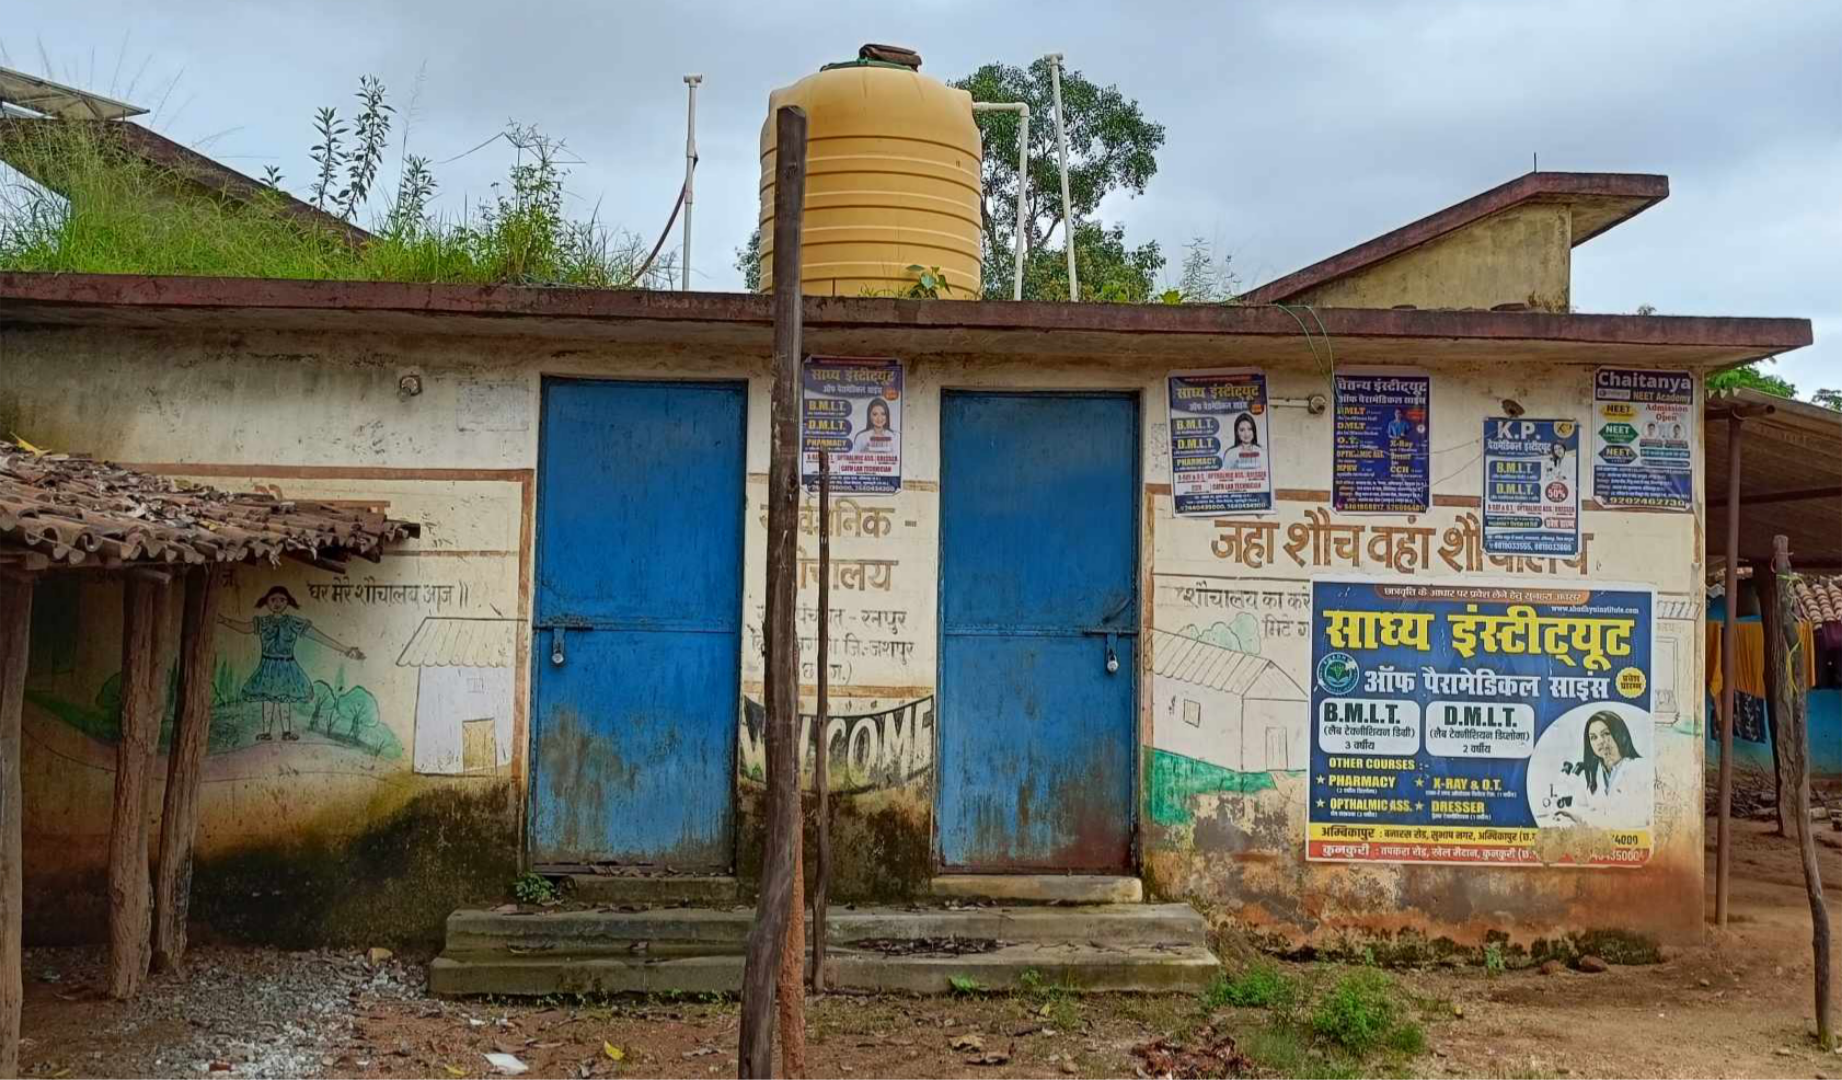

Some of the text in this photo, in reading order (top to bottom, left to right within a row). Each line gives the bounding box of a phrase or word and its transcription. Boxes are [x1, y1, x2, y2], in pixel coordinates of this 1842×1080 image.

[1598, 371, 1691, 392] Chaitanya
[1606, 404, 1631, 413] NEET
[1646, 403, 1688, 412] Admission
[1655, 413, 1677, 422] Open
[1336, 422, 1366, 430] DMLT
[1497, 421, 1541, 440] K.P.
[1605, 425, 1630, 434] NEET
[1605, 448, 1630, 457] NEET
[1283, 507, 1366, 568] शौच
[1367, 515, 1437, 574] वहां
[308, 583, 328, 599] घर
[332, 576, 352, 601] मेरे
[1430, 588, 1455, 598] आधार
[1457, 589, 1469, 598] पर
[1323, 604, 1635, 671] साध्य इंस्टीट्यूट
[1364, 665, 1417, 693] ऑफ
[1421, 666, 1541, 698] पैरामेडिकल
[1548, 670, 1610, 701] साइंस
[1324, 702, 1401, 724] B.M.L.T.
[1444, 705, 1517, 728] D.M.L.T.
[1344, 738, 1375, 750] 3 वर्षीय
[1462, 742, 1491, 754] 2 वर्षीय
[1329, 757, 1364, 769] OTHER
[1365, 758, 1415, 770] COURSES
[1328, 774, 1396, 789] PHARMACY
[1433, 777, 1502, 791] X-RAY & O.T.
[1330, 797, 1413, 812] OPTHALMIC ASS.
[1430, 800, 1485, 813] DRESSER
[1321, 825, 1375, 841] अम्बिकापुर
[1611, 834, 1638, 846] 4000
[1322, 842, 1370, 858] कुनकुरी
